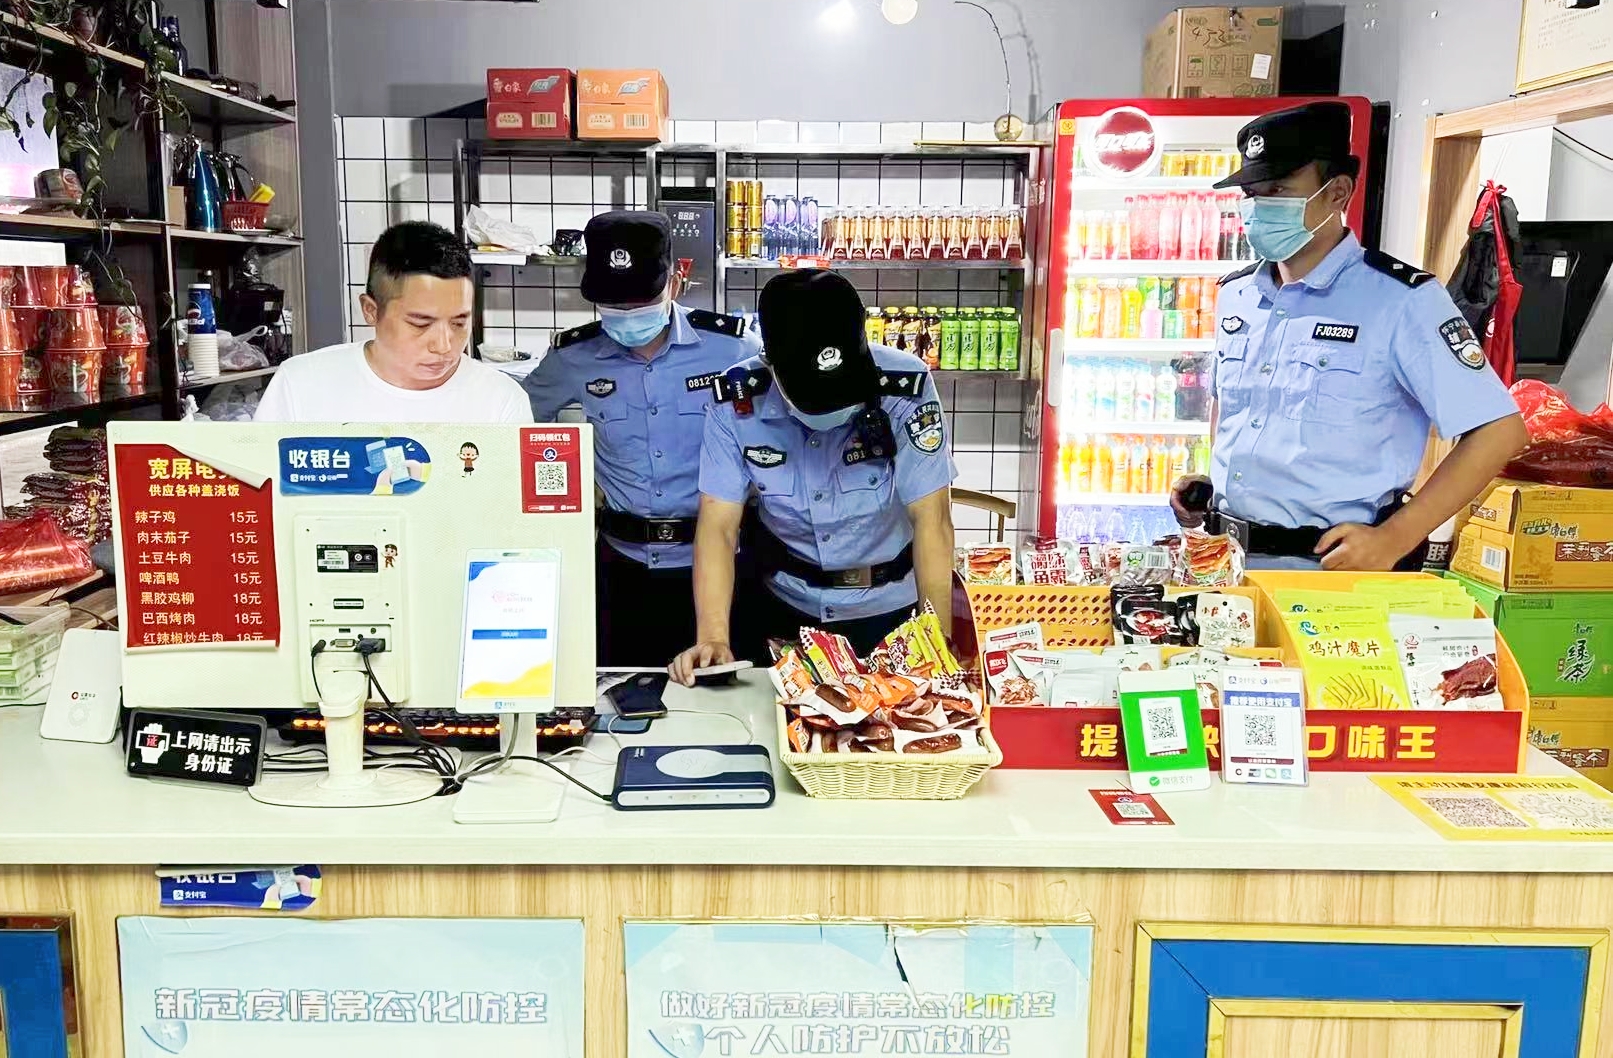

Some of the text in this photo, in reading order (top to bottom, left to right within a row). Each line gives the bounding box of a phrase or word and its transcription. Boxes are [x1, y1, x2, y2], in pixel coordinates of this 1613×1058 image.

[1315, 325, 1354, 339] FJ03289
[688, 374, 721, 389] 0812
[288, 449, 350, 469] 收银台
[148, 457, 230, 480] 宽屏电
[148, 484, 240, 497] 供应各种盖浇饭
[135, 511, 258, 524] 辣子鸡 15元
[137, 531, 258, 544] 肉末茄子 15元
[138, 551, 259, 565] 土豆牛肉 15元
[139, 571, 262, 585] 啤酒鸭 15元
[140, 591, 262, 605] 黑胶鸡柳 18元
[142, 612, 263, 625] 巴西烤肉 18元
[1308, 640, 1380, 657] 鸡汁魔片
[1564, 639, 1594, 684] 绿茶
[170, 730, 252, 755] 上网请出示
[1306, 725, 1437, 760] 口味王
[184, 754, 234, 775] 身份证
[184, 890, 207, 899] 支付宝
[154, 987, 548, 1024] 新冠疫情常态化防控
[660, 990, 1056, 1019] 做好新冠疫情常态化防控
[704, 1024, 1011, 1056] 个人防护不放松
